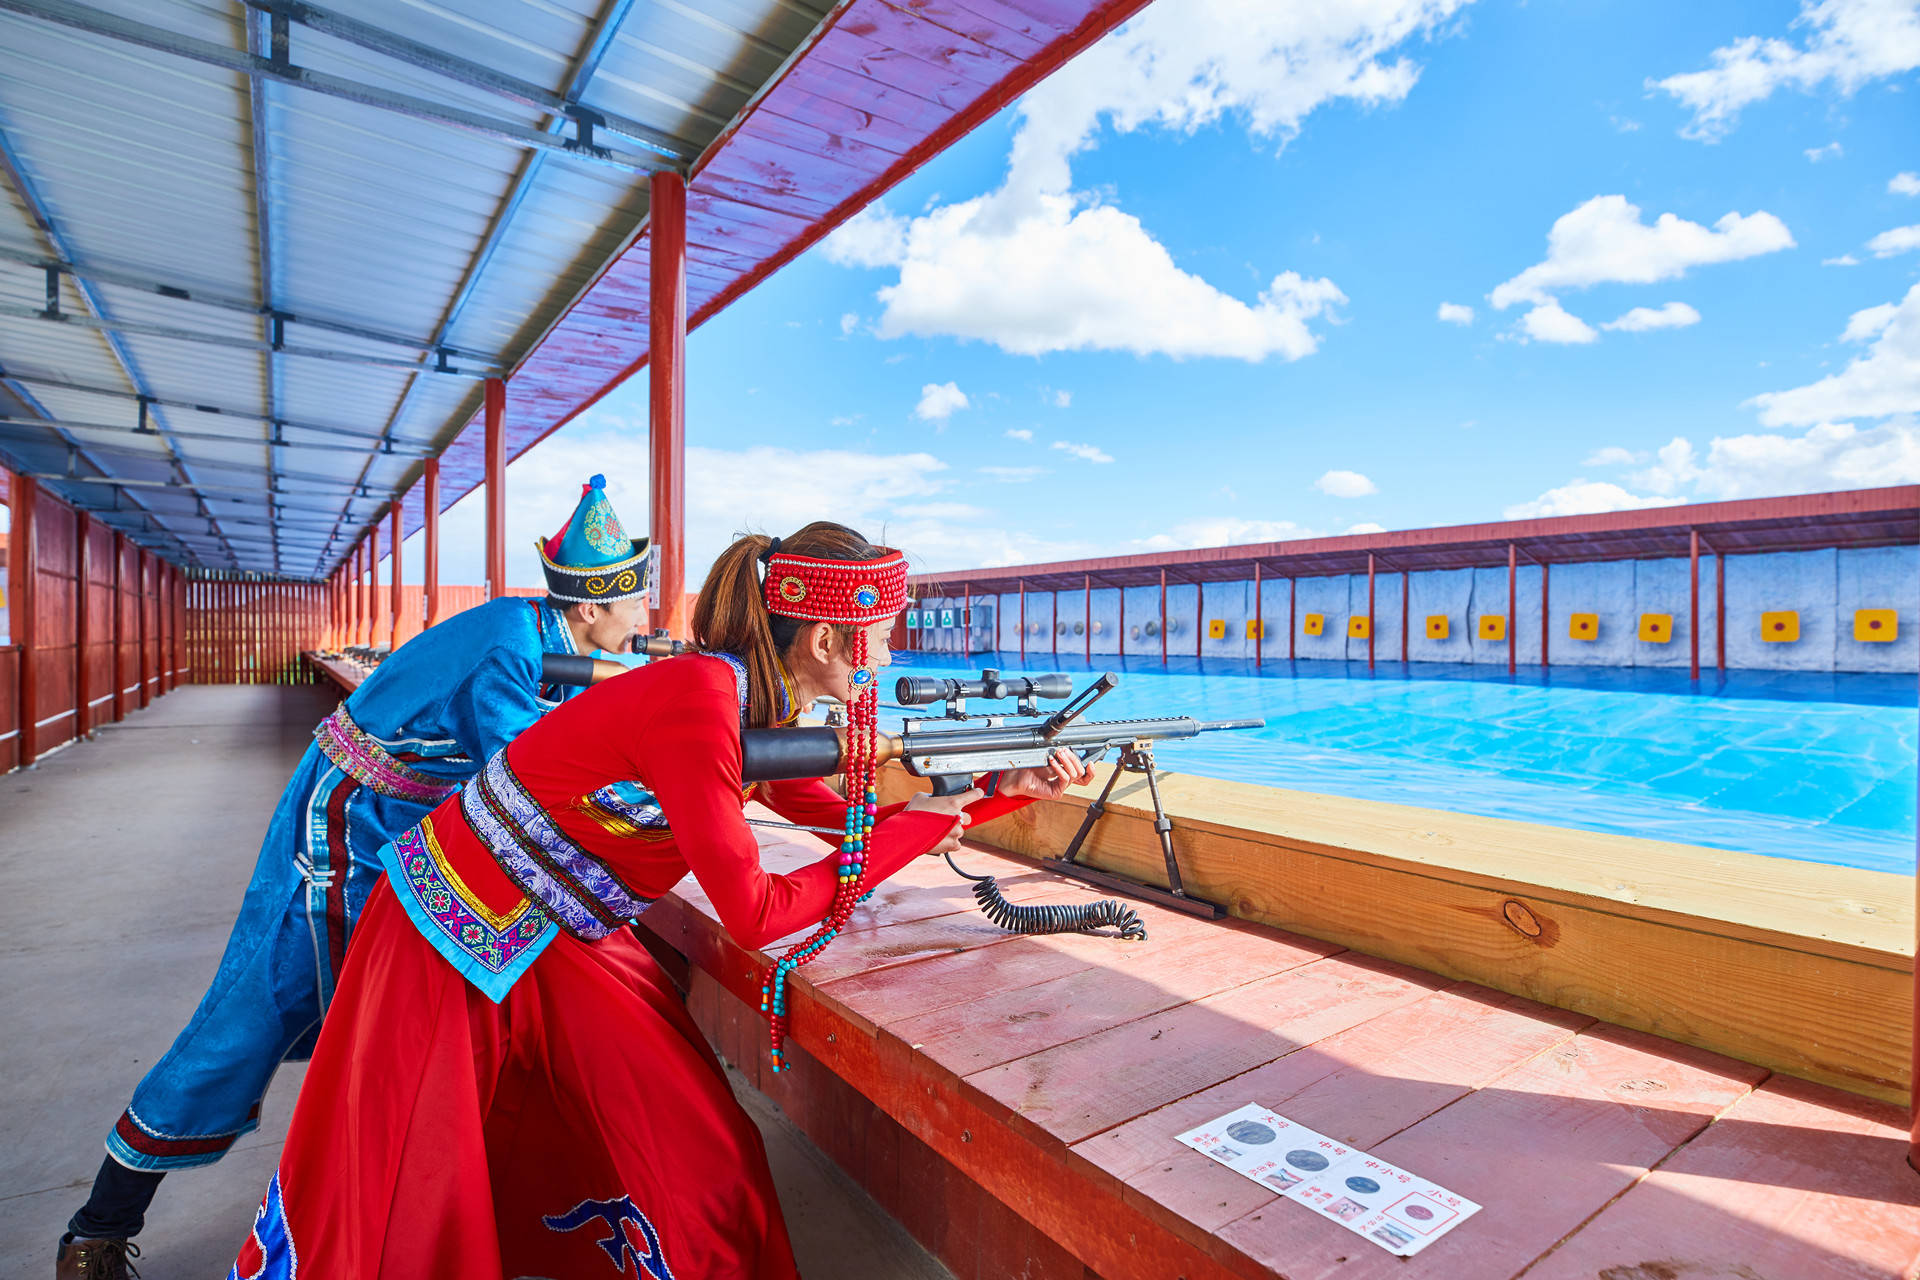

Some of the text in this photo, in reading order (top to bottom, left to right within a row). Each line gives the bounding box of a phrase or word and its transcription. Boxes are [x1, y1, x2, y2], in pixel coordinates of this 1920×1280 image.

[1261, 1115, 1289, 1129] 大号
[1318, 1141, 1347, 1155] 中号
[1364, 1160, 1411, 1183] 中小号
[1427, 1190, 1461, 1207] 小号
